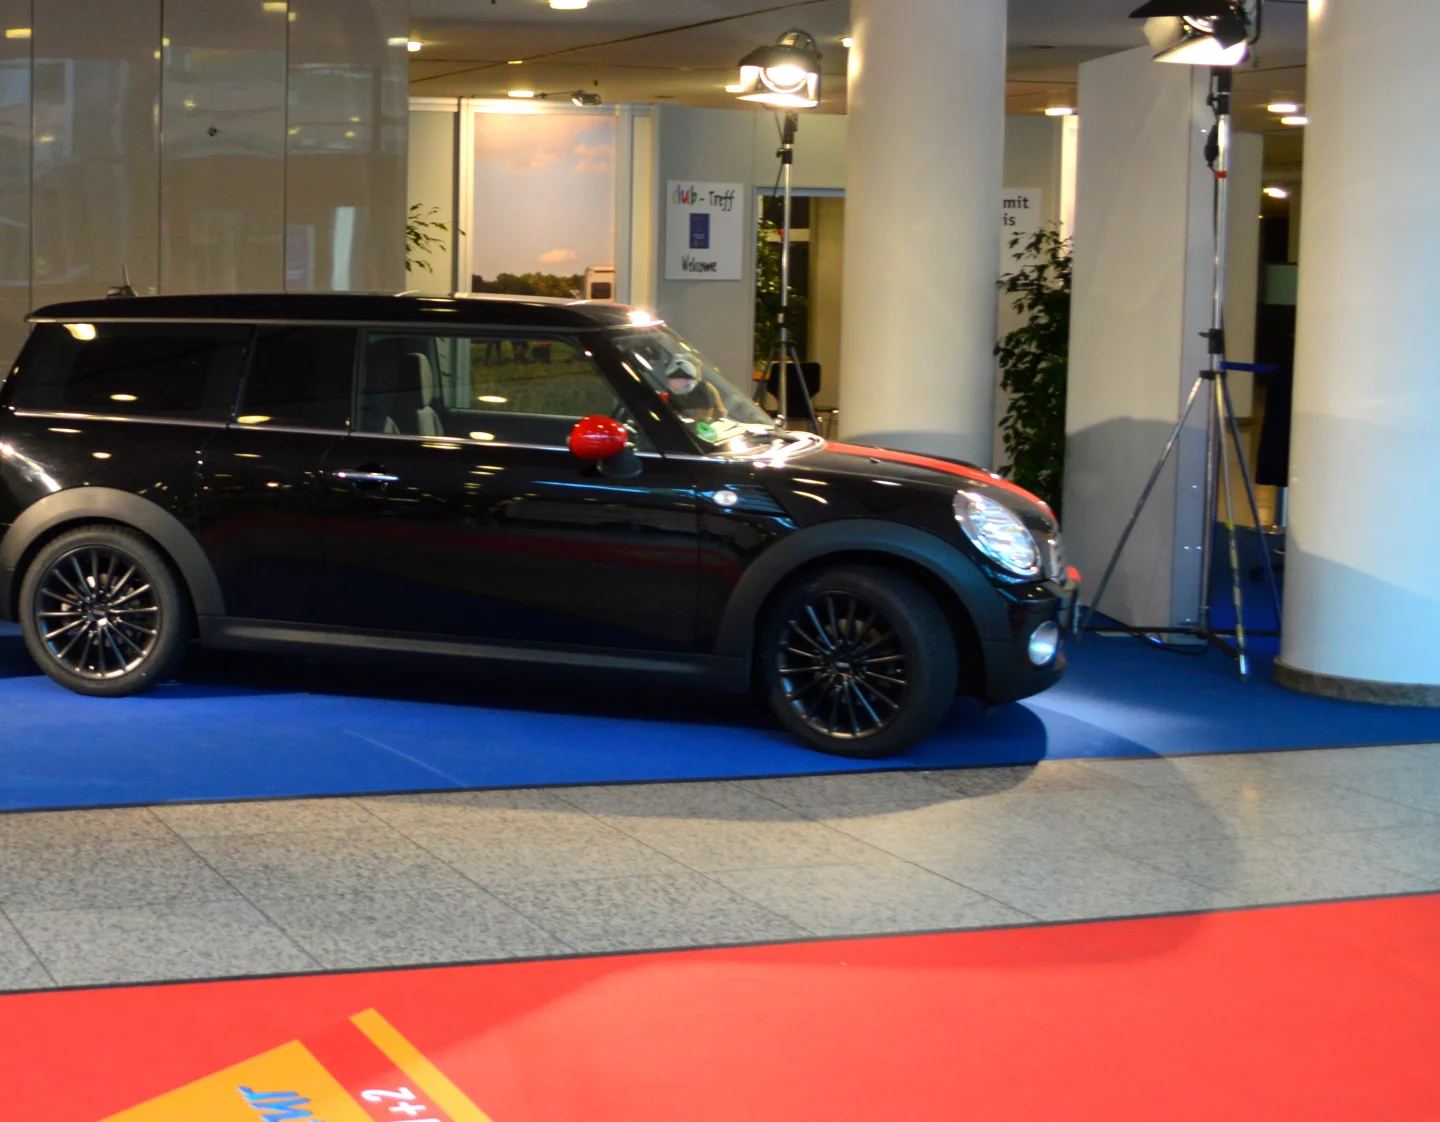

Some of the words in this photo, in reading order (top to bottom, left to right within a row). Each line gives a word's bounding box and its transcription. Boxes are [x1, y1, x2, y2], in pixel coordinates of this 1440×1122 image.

[672, 184, 698, 206] club
[709, 189, 735, 212] Treff
[1003, 195, 1029, 209] mit
[682, 254, 717, 273] Welcome
